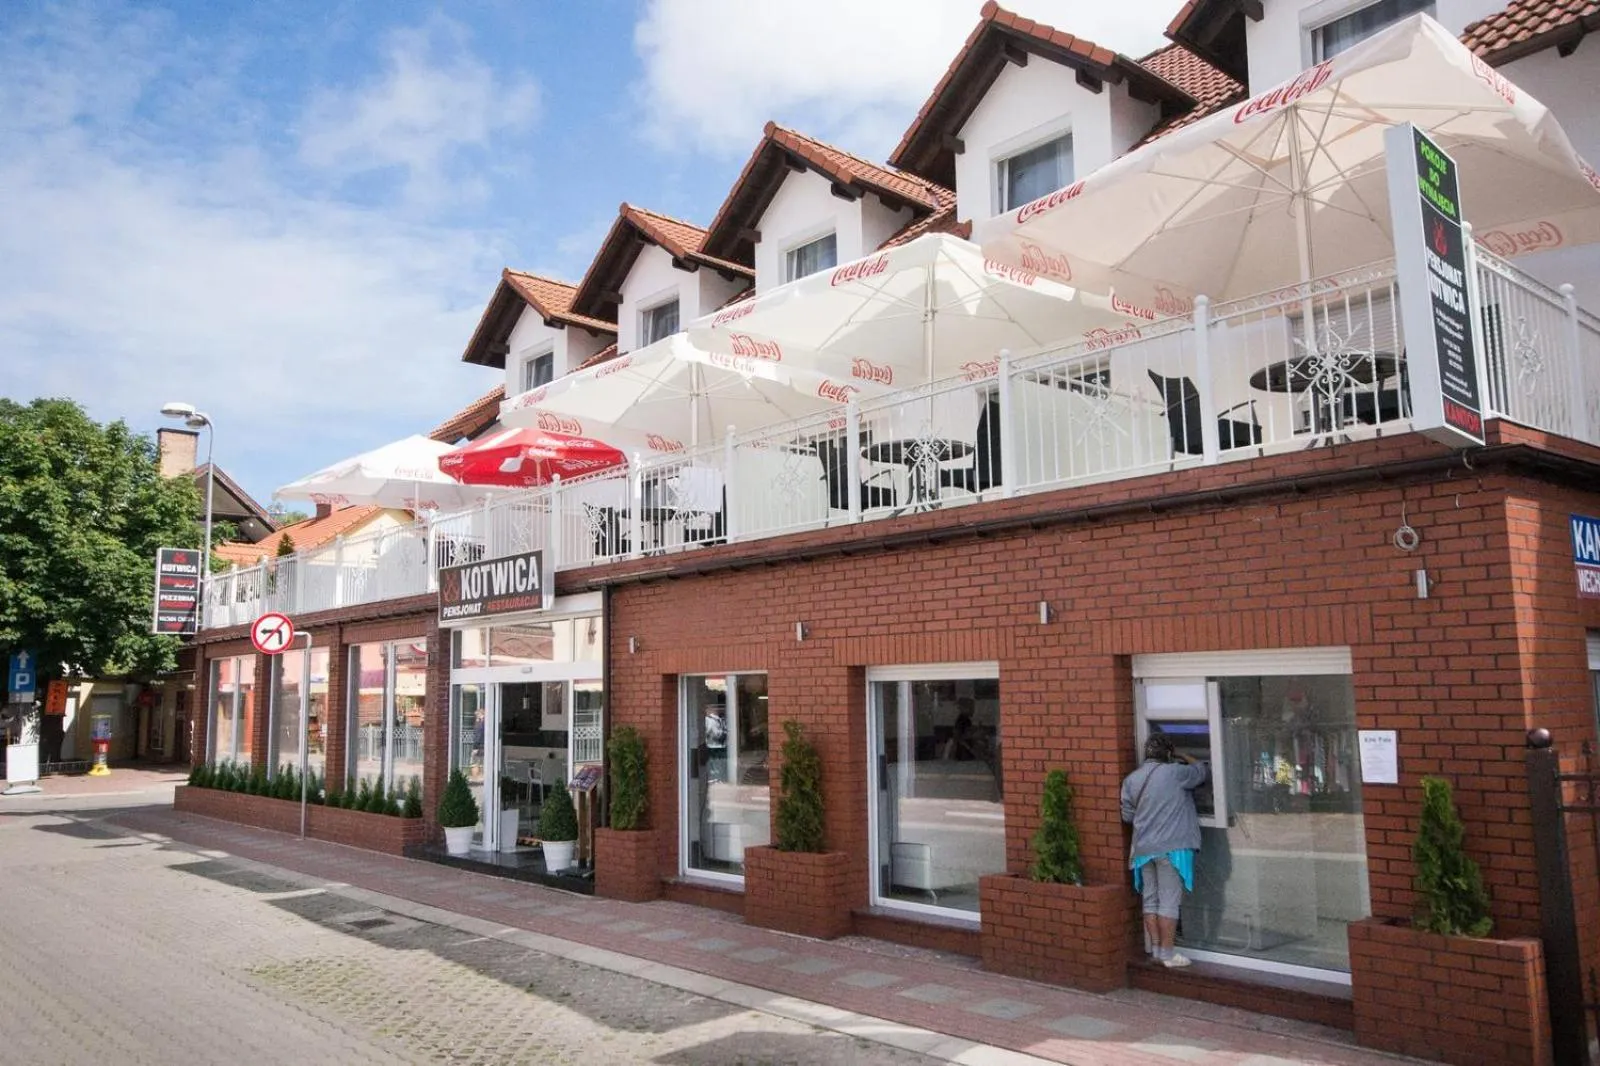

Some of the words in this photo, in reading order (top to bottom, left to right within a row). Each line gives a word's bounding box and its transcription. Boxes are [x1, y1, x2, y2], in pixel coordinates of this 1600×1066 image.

[1421, 140, 1448, 175] POKOJE
[161, 563, 197, 574] KOTWICA
[460, 556, 540, 601] KOTWICA
[443, 602, 482, 618] PENSJONAT
[487, 595, 540, 611] RESTAURACJA
[15, 673, 30, 690] P
